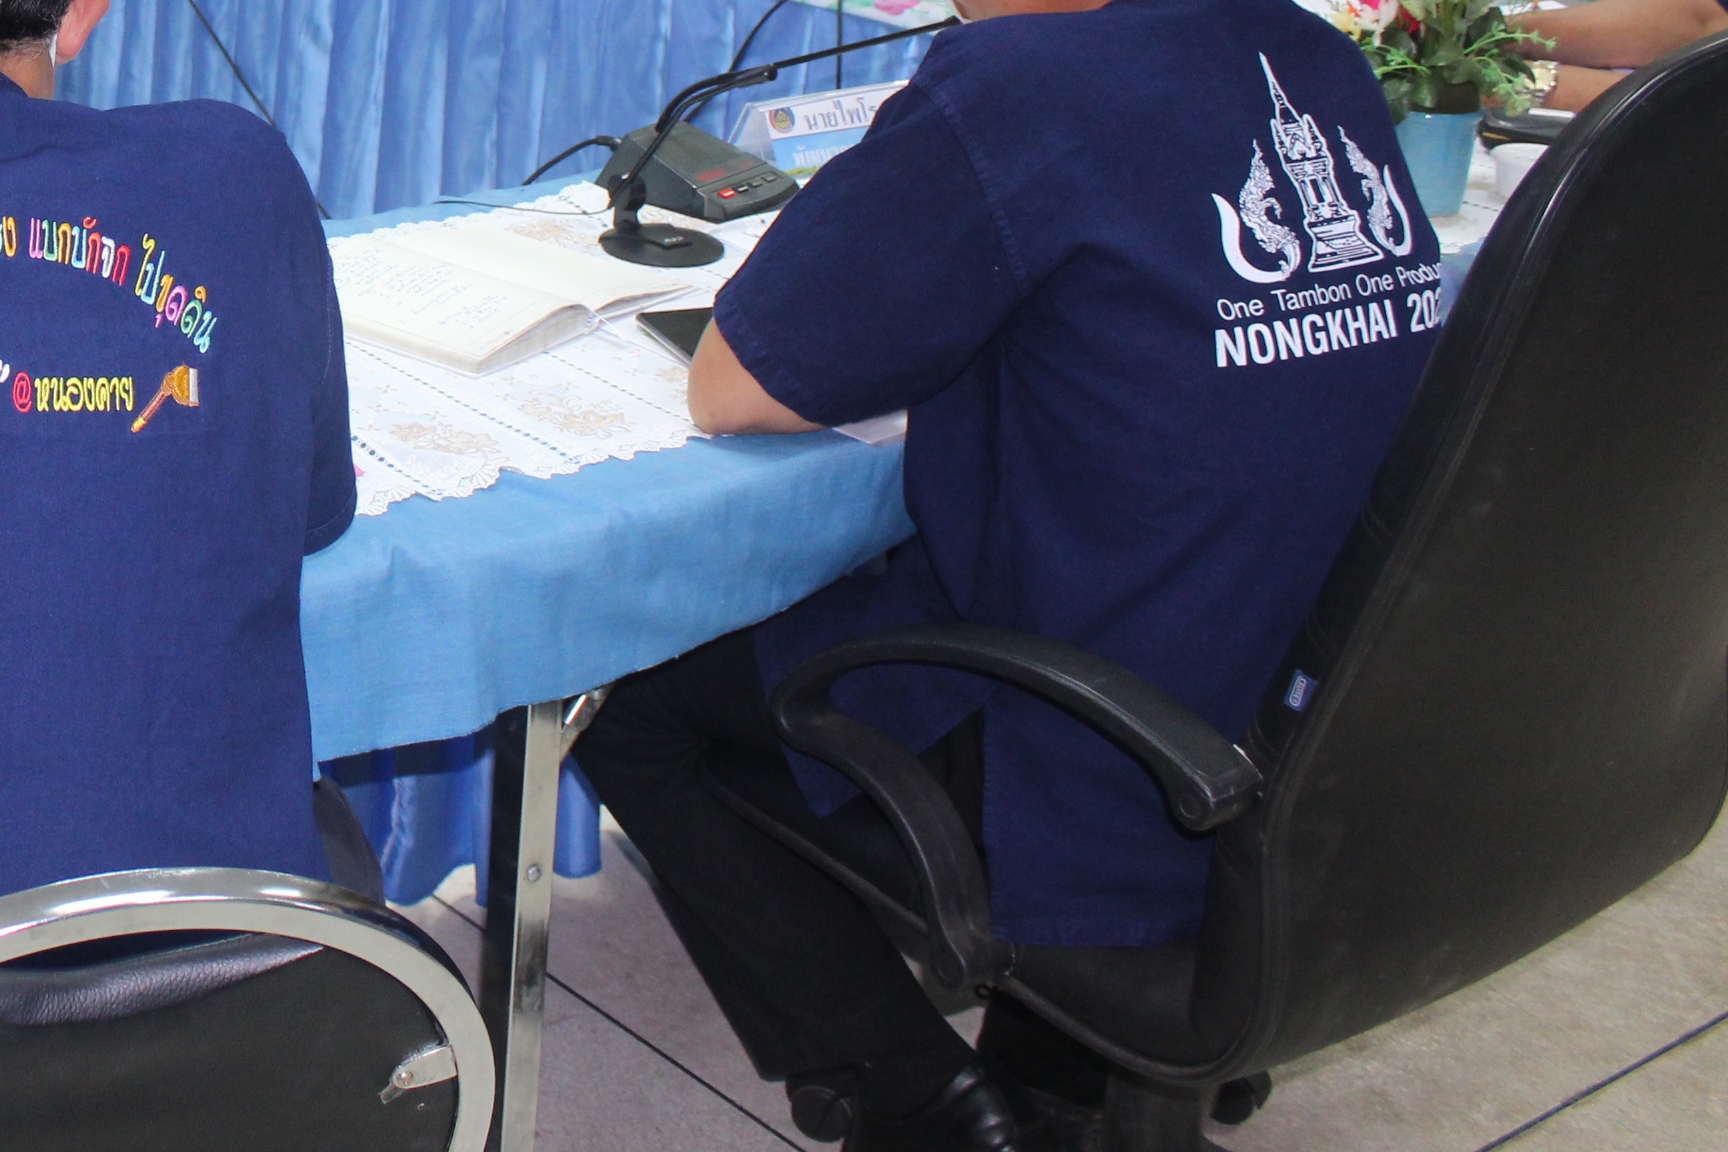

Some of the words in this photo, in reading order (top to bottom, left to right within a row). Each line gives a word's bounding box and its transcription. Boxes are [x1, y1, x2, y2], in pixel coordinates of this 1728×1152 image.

[1216, 298, 1265, 321] One
[1270, 283, 1352, 312] Tambon
[1355, 273, 1395, 297] One
[1395, 262, 1442, 288] Produ
[1214, 298, 1399, 368] NONGKHAI
